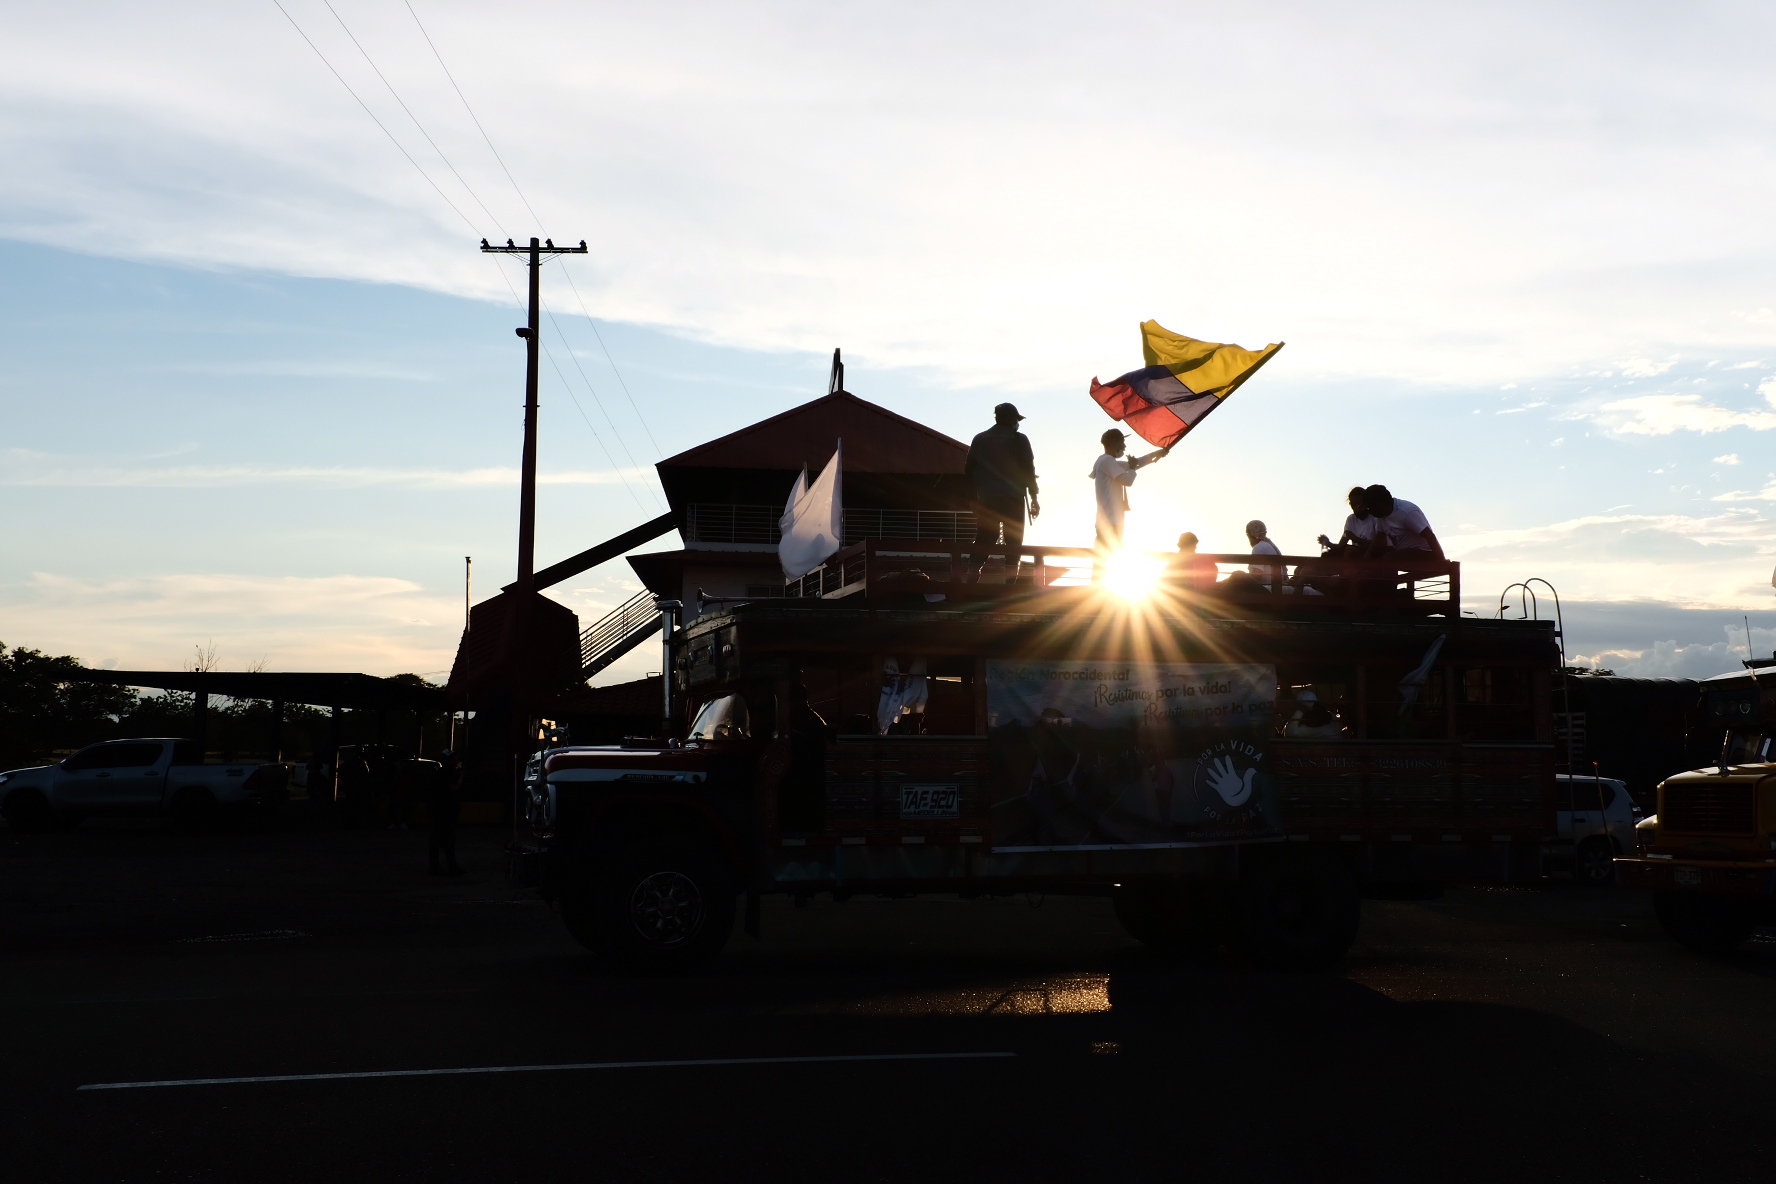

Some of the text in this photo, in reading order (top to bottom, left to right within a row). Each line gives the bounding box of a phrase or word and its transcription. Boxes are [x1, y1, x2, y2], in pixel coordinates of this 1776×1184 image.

[1155, 686, 1179, 701] por
[1183, 684, 1195, 697] la
[1199, 681, 1232, 696] vida!
[1205, 706, 1229, 720] por
[1232, 702, 1244, 715] la
[1197, 740, 1263, 765] POR LA VIDA
[1204, 806, 1222, 821] POR
[1241, 802, 1263, 822] PAZ
